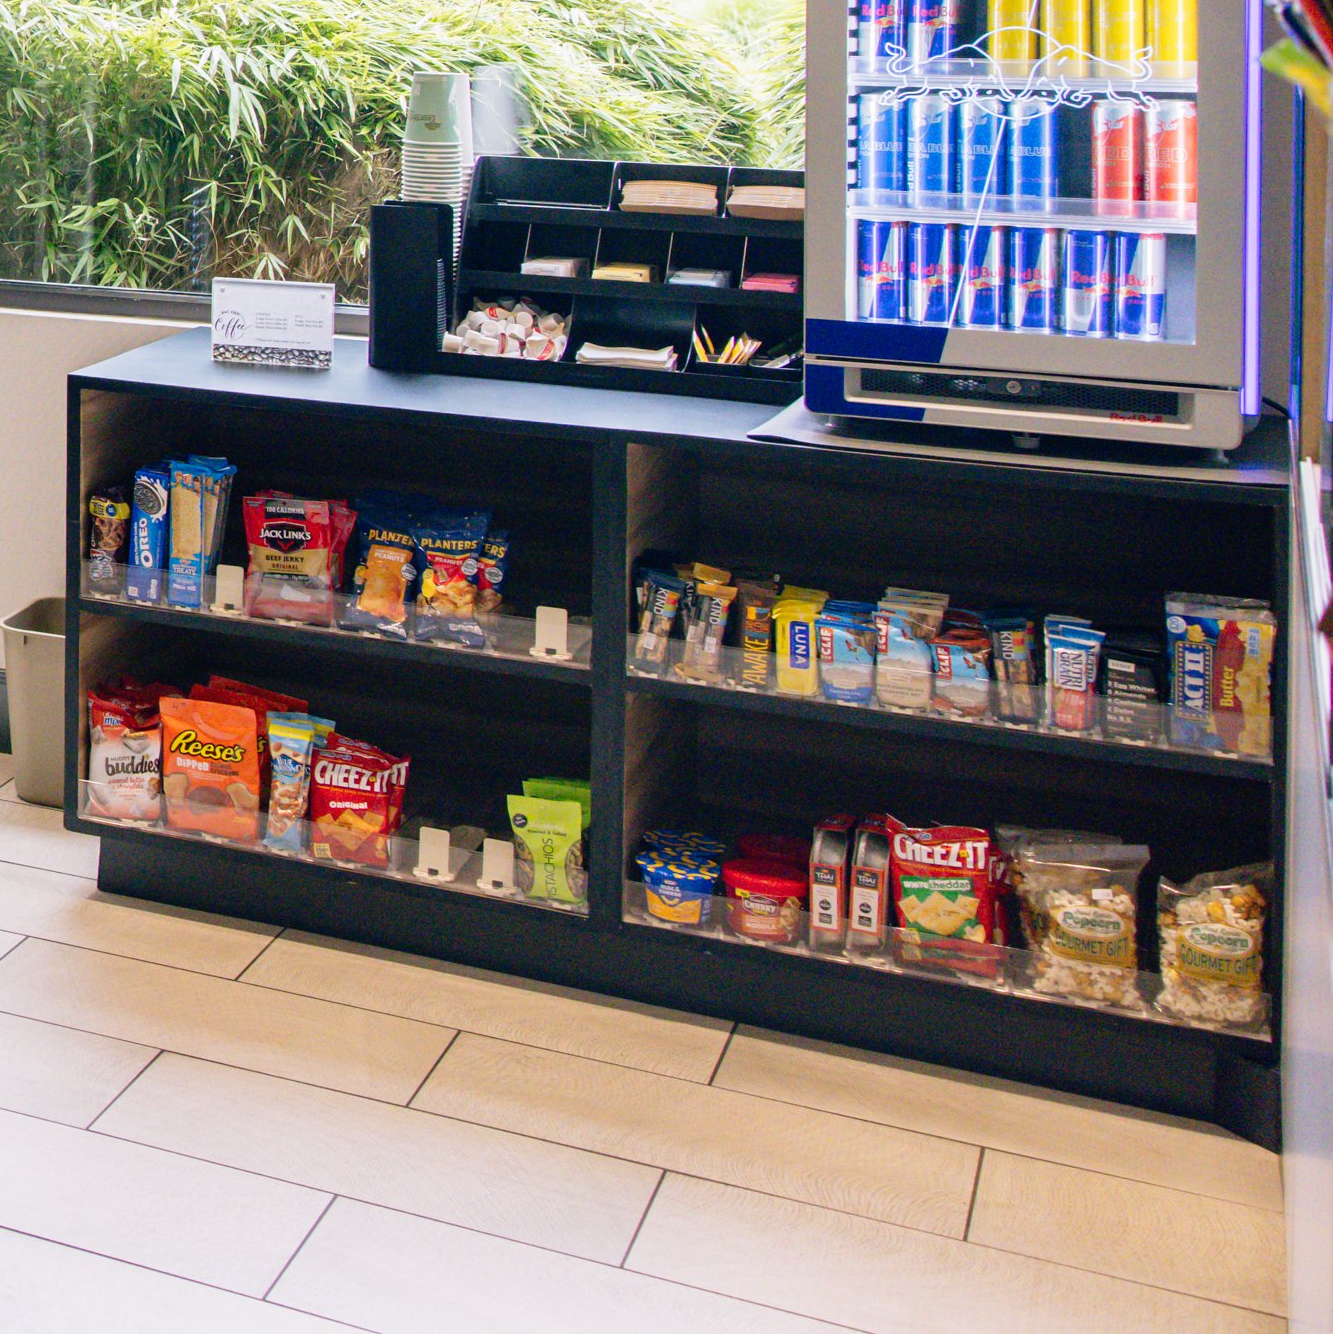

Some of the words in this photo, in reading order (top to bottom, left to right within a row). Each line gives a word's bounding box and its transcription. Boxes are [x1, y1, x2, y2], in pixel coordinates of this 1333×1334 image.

[941, 6, 960, 18] Bu
[1071, 270, 1097, 284] Red
[214, 316, 246, 340] Coffee
[277, 507, 305, 516] CALORIES
[139, 517, 153, 568] OREO
[259, 527, 282, 540] JACK
[368, 528, 415, 546] PLANTER
[421, 538, 478, 551] PLANTERS
[265, 554, 282, 563] BEEF
[283, 555, 305, 564] JERKY
[373, 551, 405, 563] PEANUTS
[173, 567, 197, 576] TREATS
[653, 586, 669, 616] KIND
[709, 597, 723, 626] KIND
[820, 627, 833, 657] CLIF
[876, 616, 889, 644] CLIF
[791, 624, 808, 667] LUNA
[936, 646, 951, 672] CLIF
[1000, 631, 1014, 660] KIND
[742, 634, 770, 686] AWAKE
[1060, 651, 1072, 688] GRAIN
[1071, 652, 1083, 688] NUTRI
[1183, 677, 1204, 713] ACT
[1219, 666, 1235, 708] Butter
[170, 729, 246, 763] Reese's
[105, 754, 161, 776] buddies
[314, 760, 391, 793] CHEEZ-IT
[893, 833, 989, 871] CHEEZ-IT
[929, 879, 972, 891] cheddar
[1062, 910, 1122, 932] Popcorn
[1054, 932, 1104, 956] GOURMET
[1106, 937, 1129, 957] GIFT
[1189, 926, 1250, 950] Popcorn
[1179, 944, 1232, 974] GOURMET
[1233, 955, 1258, 976] GIFT
